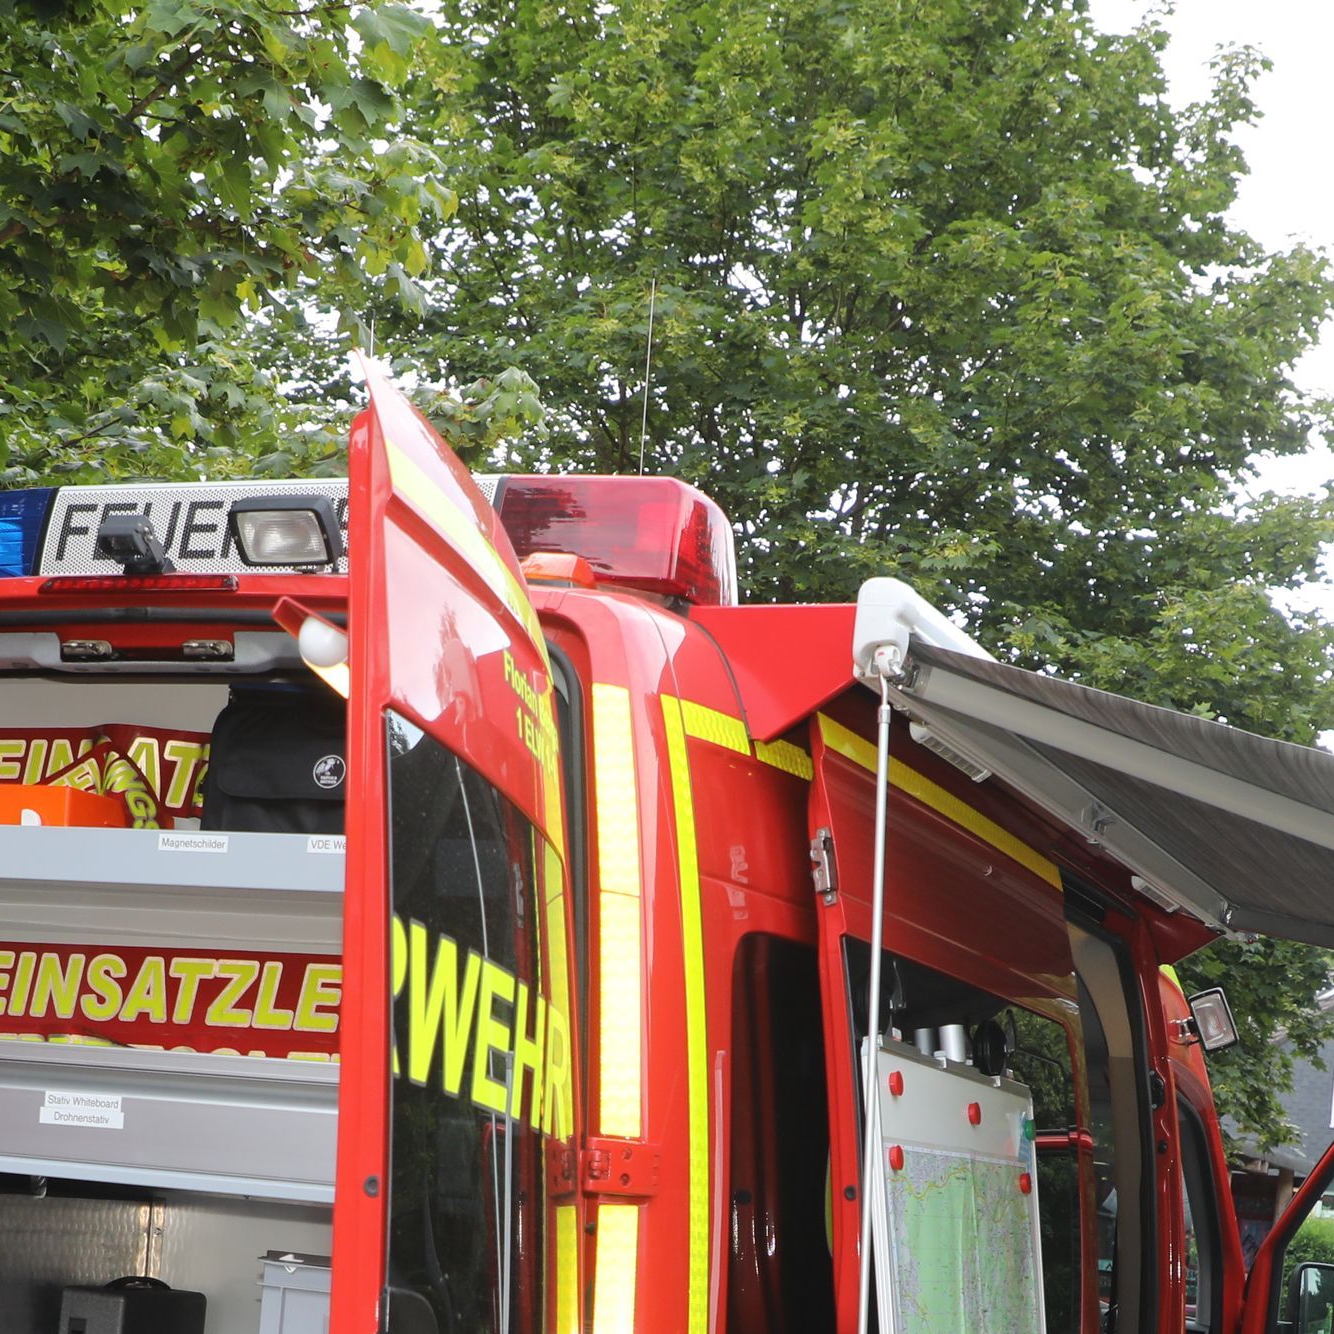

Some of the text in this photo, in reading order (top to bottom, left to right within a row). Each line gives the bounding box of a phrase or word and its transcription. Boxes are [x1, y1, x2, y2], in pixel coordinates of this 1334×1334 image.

[161, 837, 226, 849] Magnetschilder
[311, 839, 330, 850] VDE
[47, 1094, 119, 1109] Stativ Whiteboard
[53, 1111, 109, 1124] Drohnenstativ
